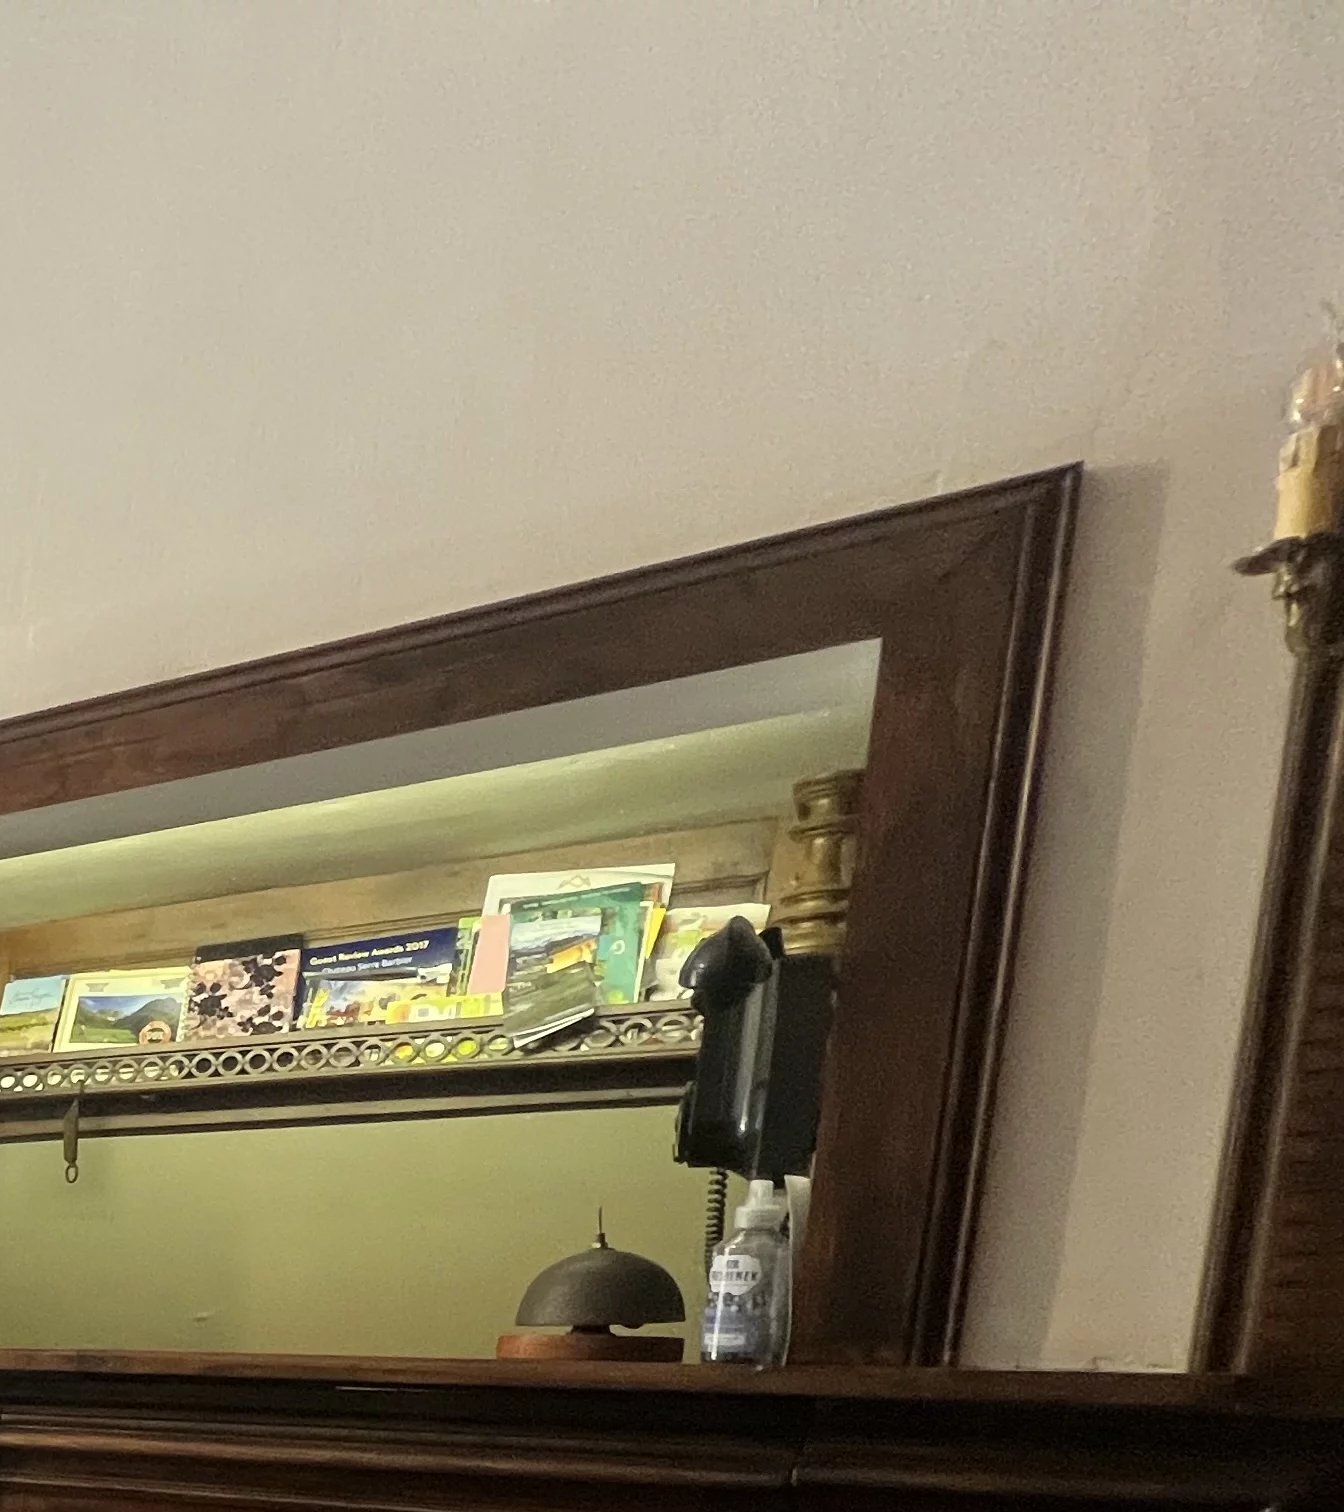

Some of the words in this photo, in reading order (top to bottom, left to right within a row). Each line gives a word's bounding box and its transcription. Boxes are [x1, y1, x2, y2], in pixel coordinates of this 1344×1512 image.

[338, 951, 370, 962] Review
[371, 945, 405, 957] Awards
[405, 940, 430, 952] 2017
